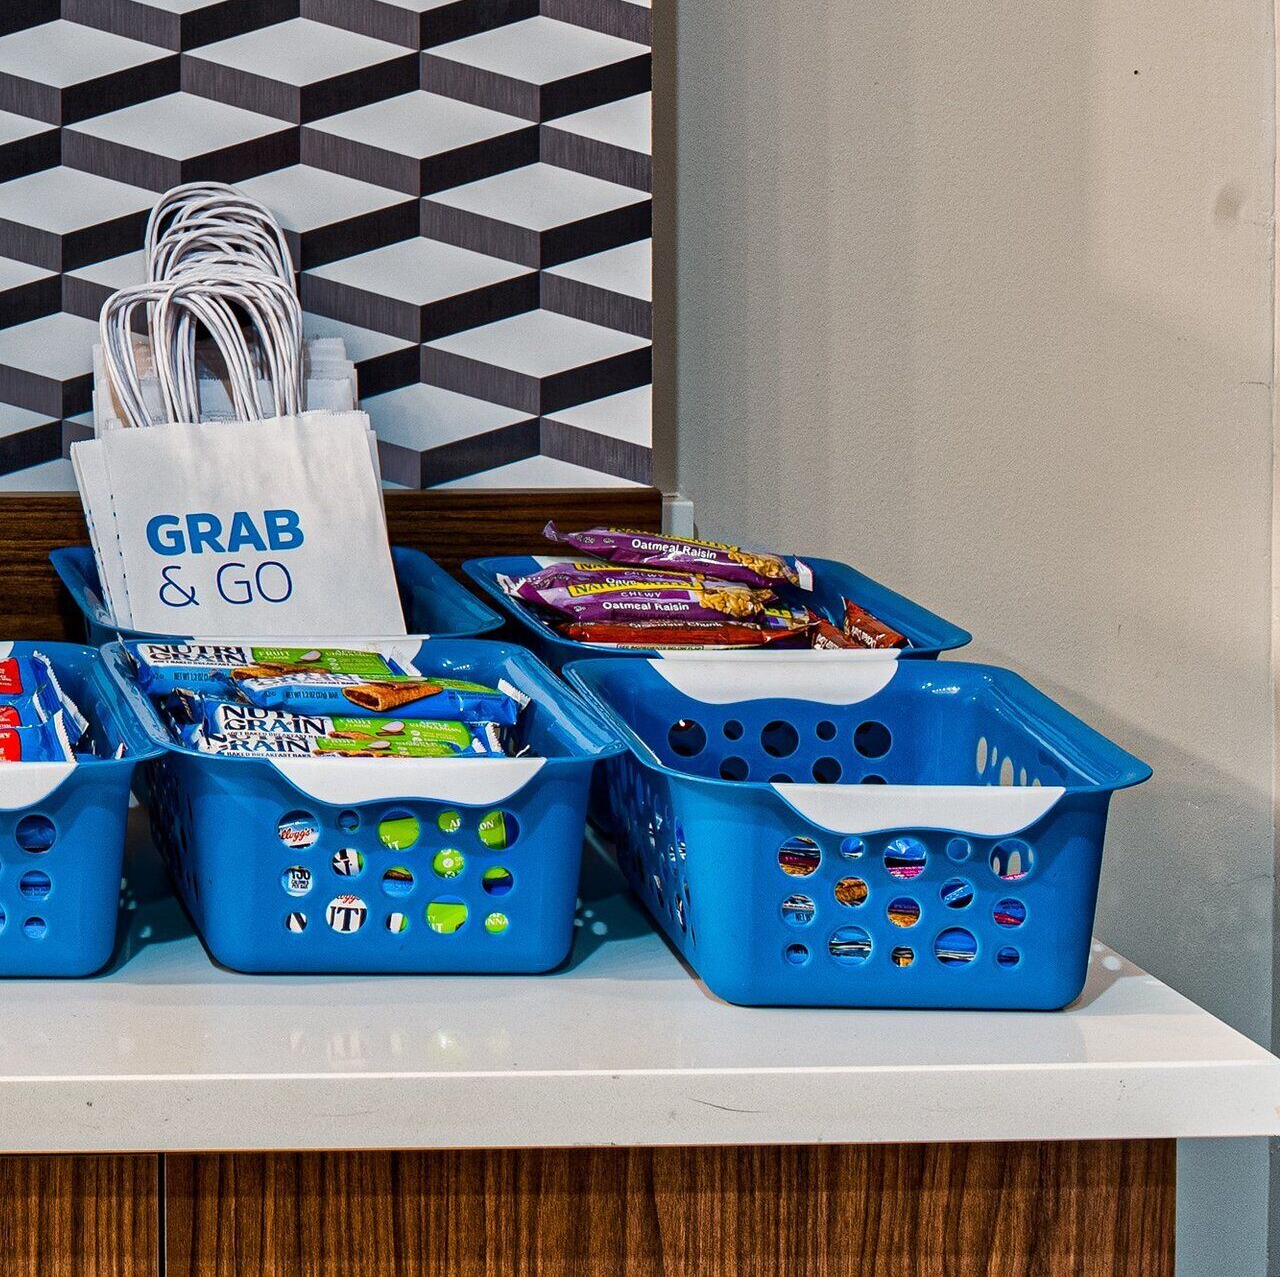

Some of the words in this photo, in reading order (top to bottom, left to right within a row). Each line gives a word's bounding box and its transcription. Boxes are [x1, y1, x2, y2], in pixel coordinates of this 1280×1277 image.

[145, 509, 305, 557] GRAB
[631, 538, 680, 555] Oatmeal
[682, 545, 718, 560] Raisin
[158, 565, 200, 608] &
[216, 561, 292, 605] GO
[620, 591, 662, 599] CHEWY
[602, 601, 652, 611] Oatmeal
[654, 602, 690, 612] Raisin
[151, 652, 249, 664] GRAIN
[225, 718, 326, 735] GRAIN
[218, 737, 312, 754] RAIN
